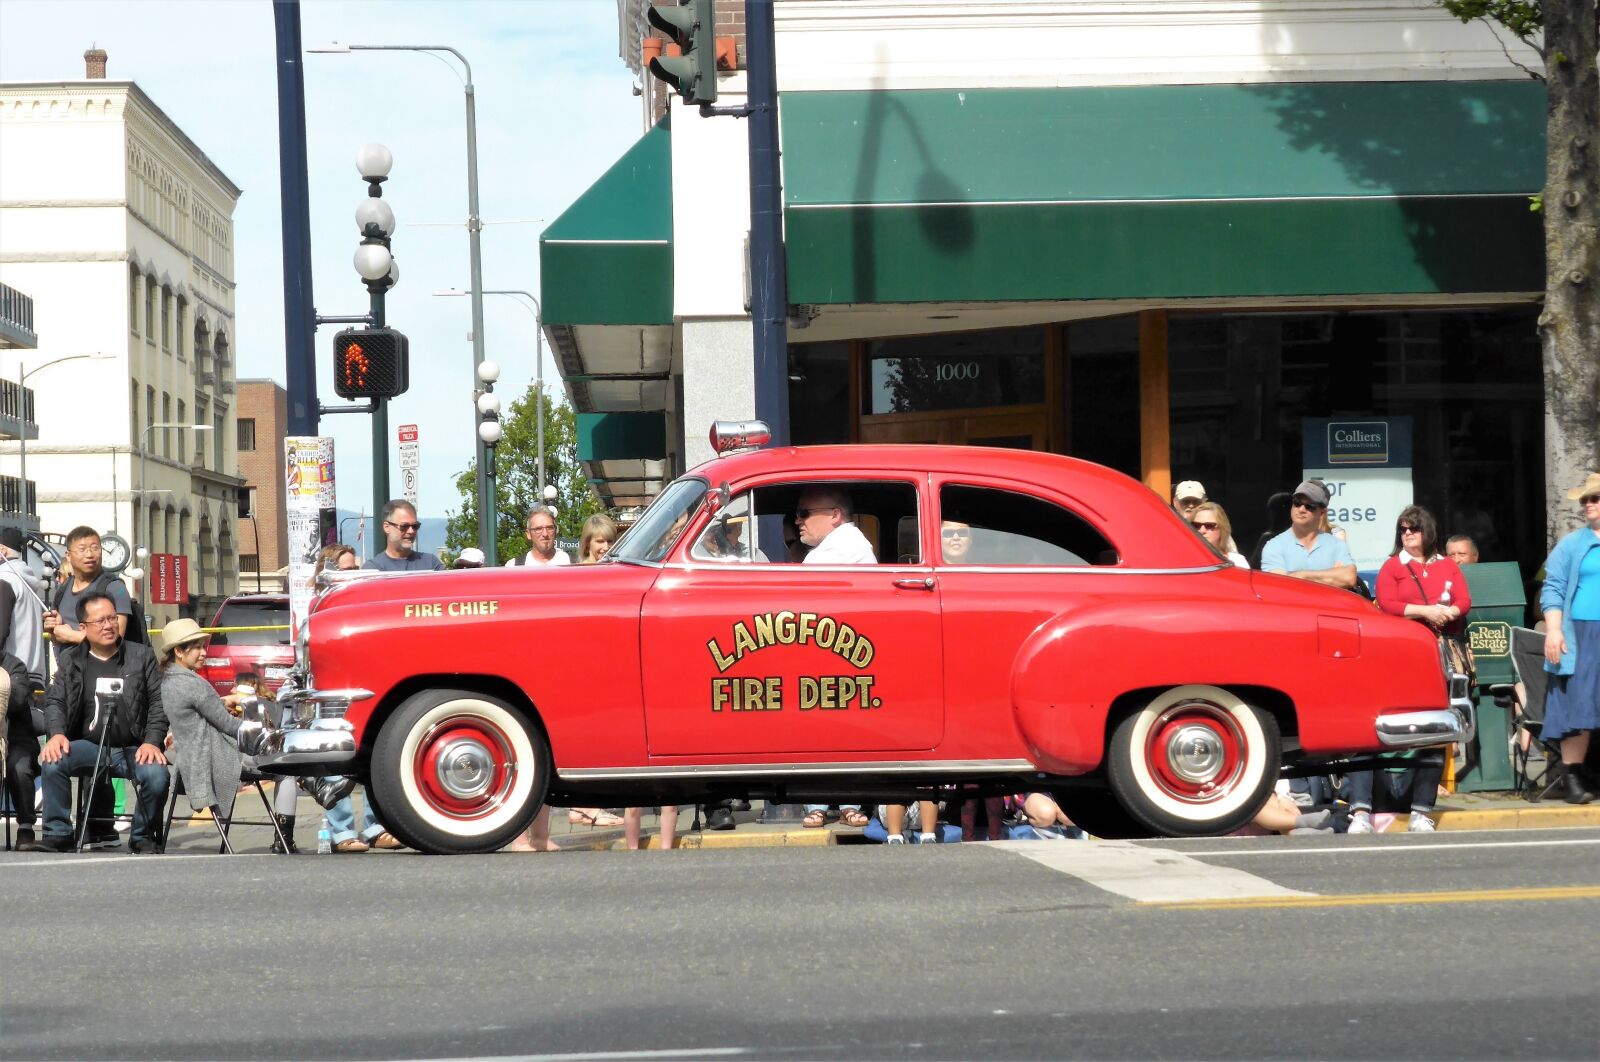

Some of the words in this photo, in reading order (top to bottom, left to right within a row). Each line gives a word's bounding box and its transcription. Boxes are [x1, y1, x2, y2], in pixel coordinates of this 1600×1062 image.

[936, 361, 979, 380] 1000
[1335, 430, 1381, 442] Colliers
[1327, 507, 1376, 522] ease
[560, 540, 580, 548] Broad
[404, 603, 442, 618] FIRE
[448, 601, 499, 616] CHIEF
[1478, 626, 1506, 639] Real
[707, 611, 875, 672] LANGFORD
[1470, 638, 1507, 649] Estate
[712, 677, 783, 711] FIRE
[799, 675, 882, 710] DEPT.
